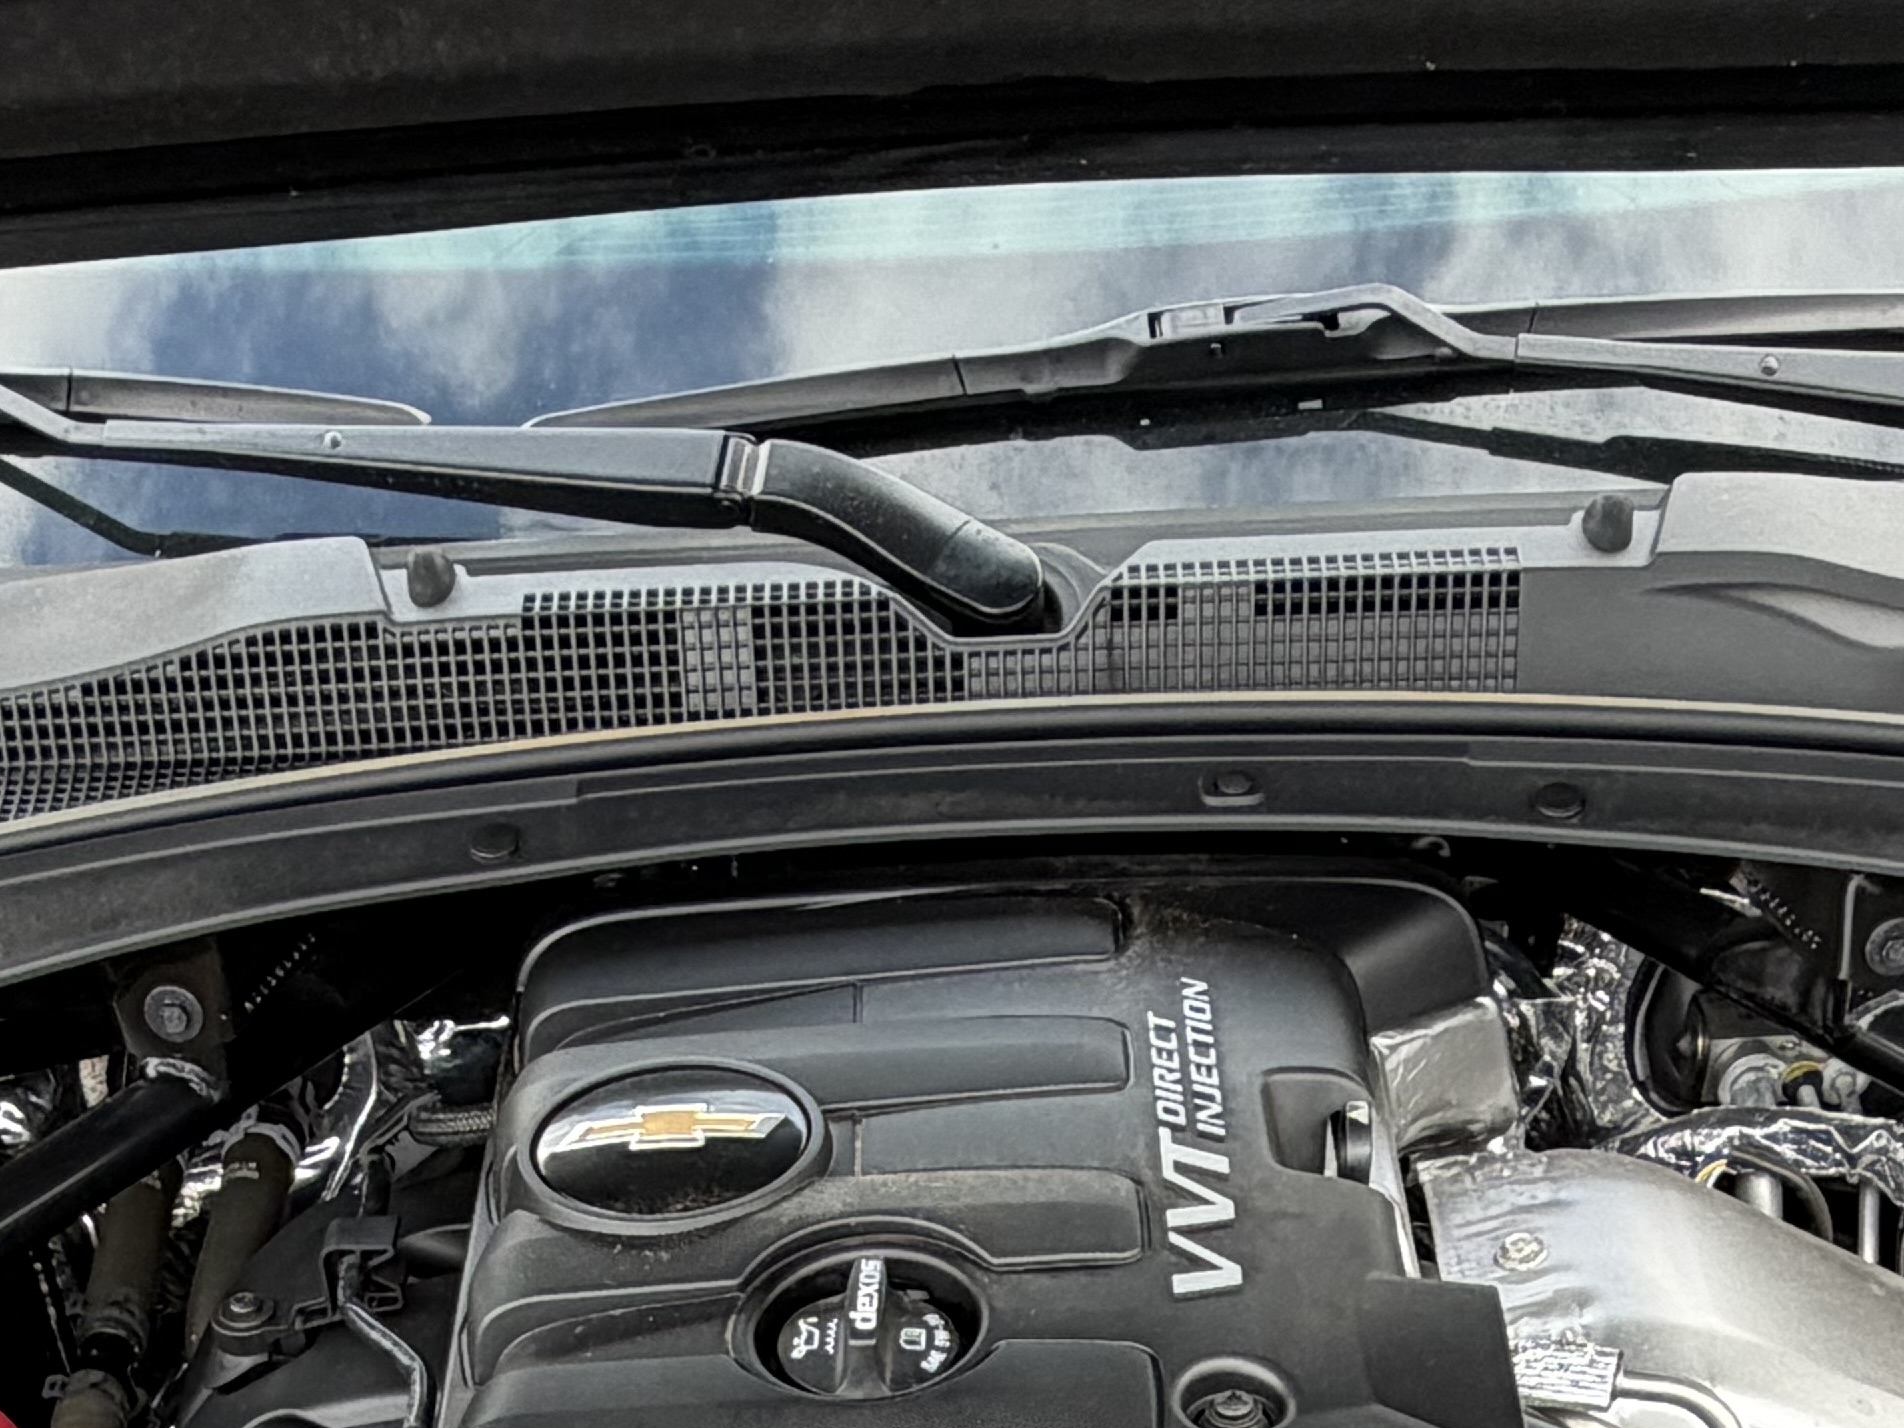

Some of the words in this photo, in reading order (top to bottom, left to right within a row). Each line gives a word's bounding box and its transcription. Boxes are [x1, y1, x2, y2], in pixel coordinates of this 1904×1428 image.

[1147, 1010, 1187, 1126] DIRECT
[1180, 976, 1226, 1136] INJECTION
[1158, 1126, 1243, 1295] VVT
[848, 1259, 883, 1330] dexos
